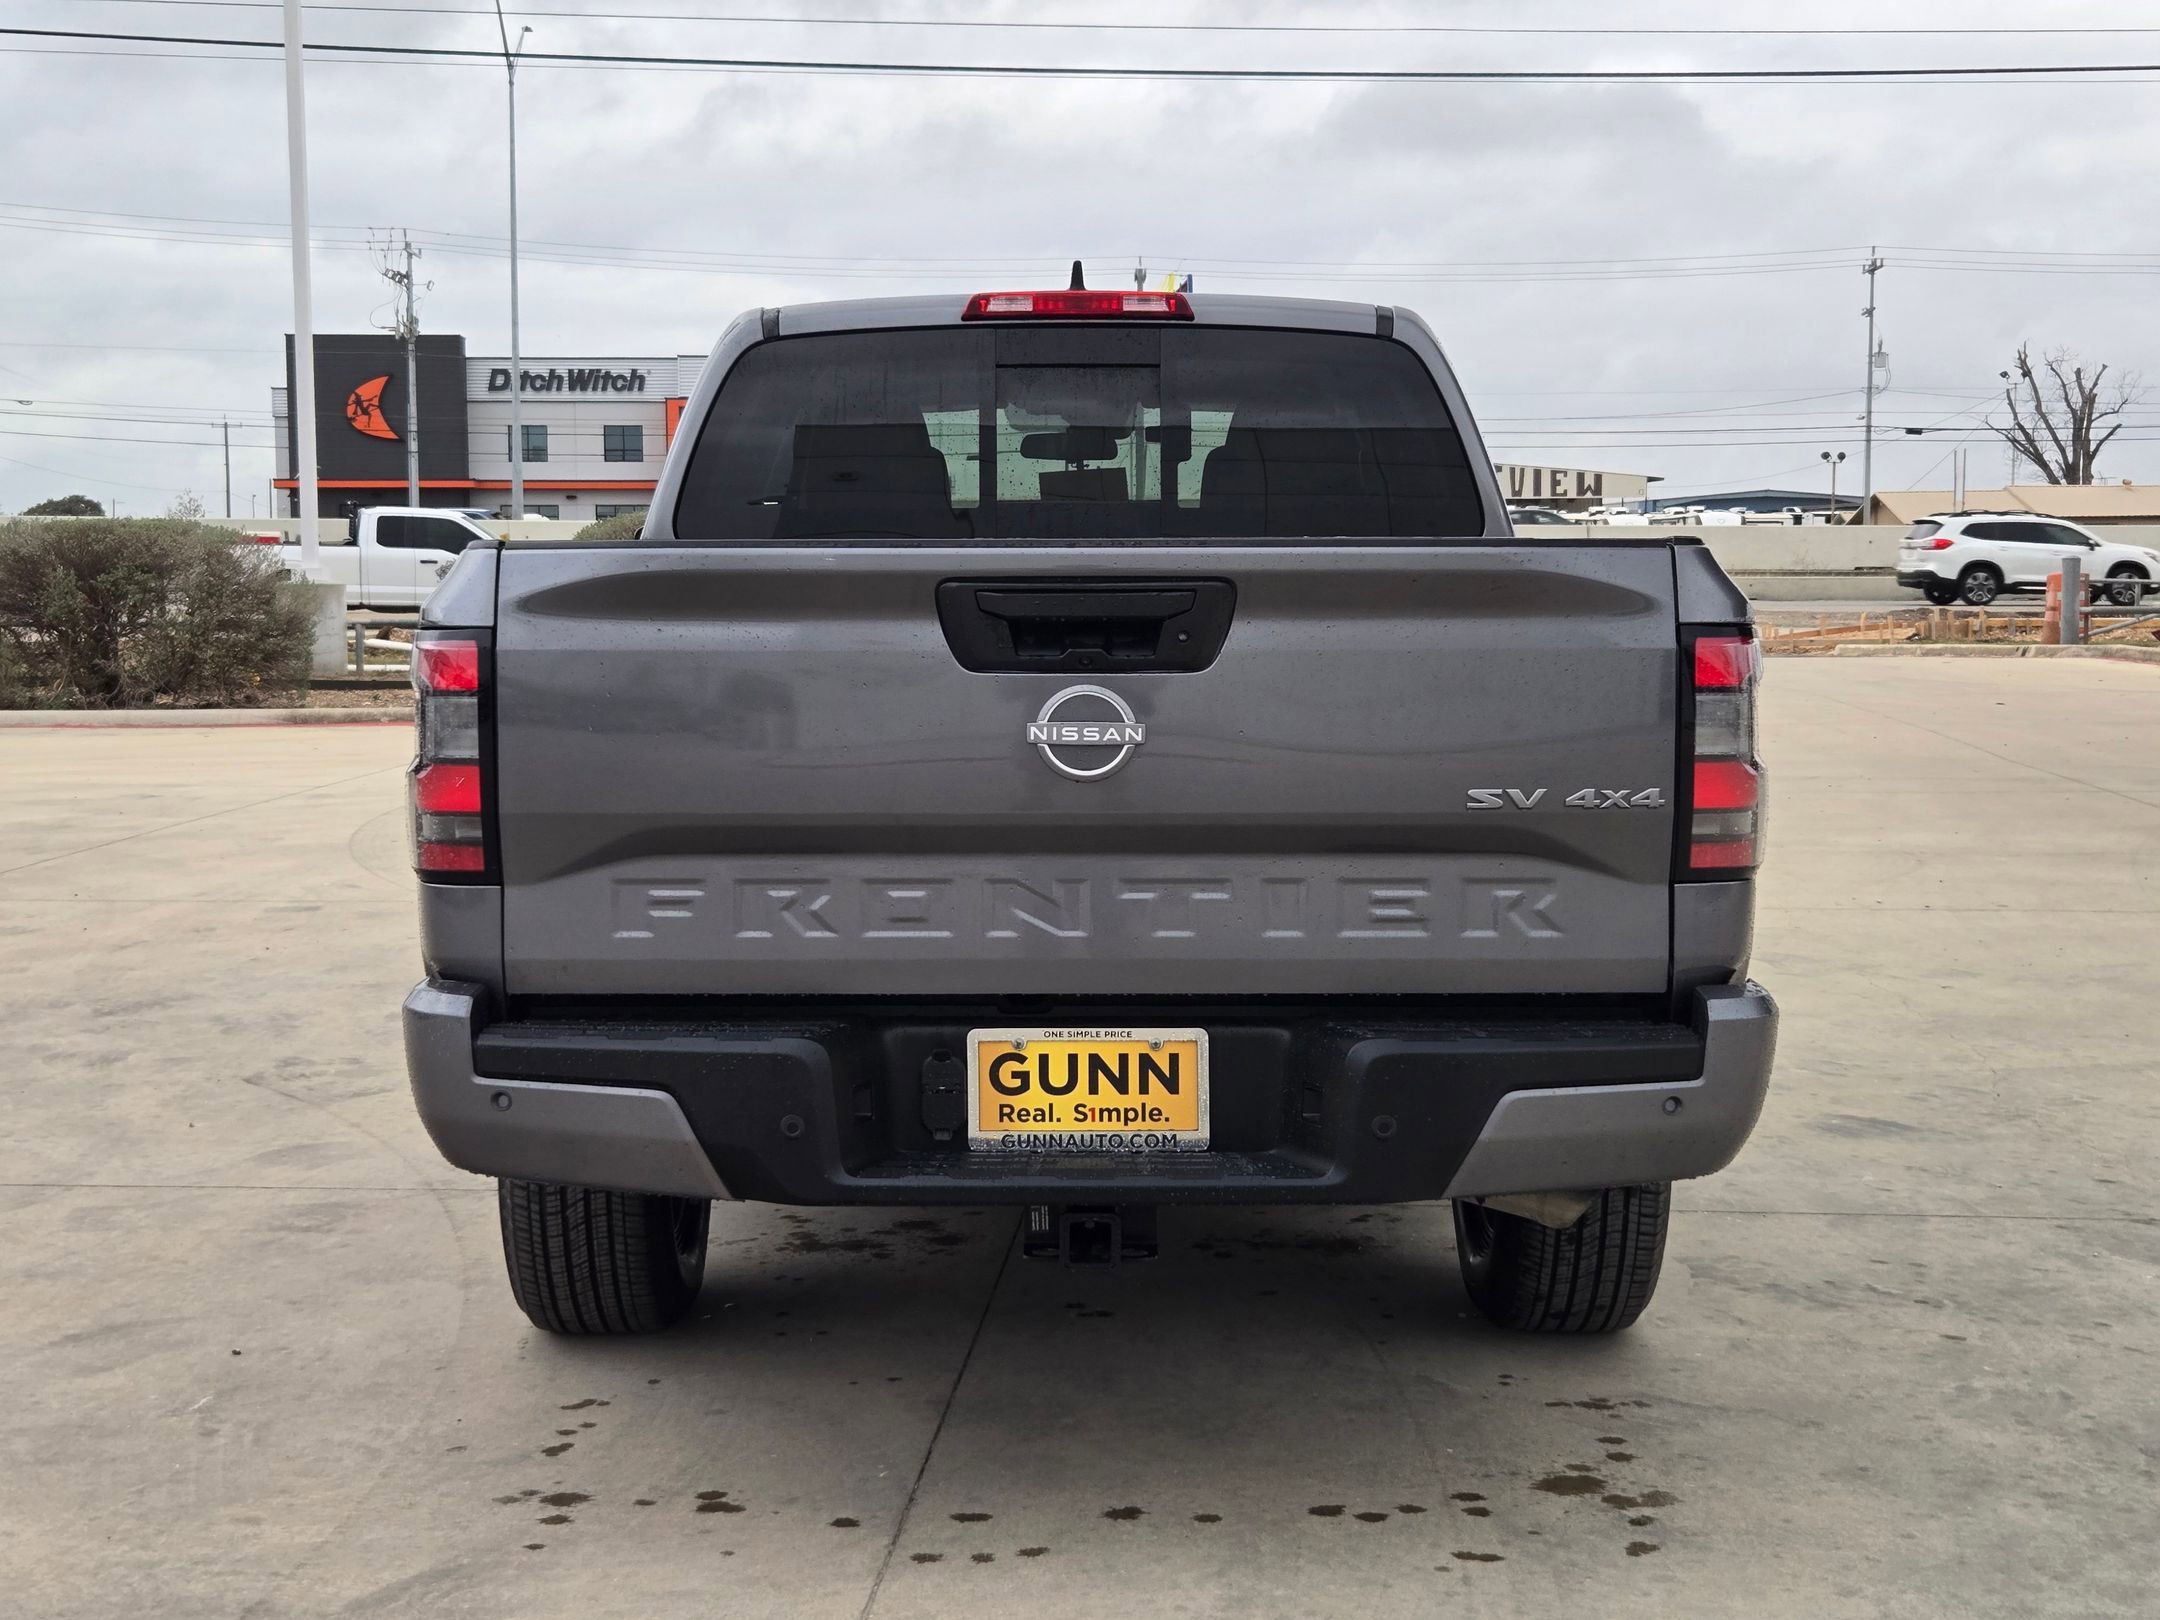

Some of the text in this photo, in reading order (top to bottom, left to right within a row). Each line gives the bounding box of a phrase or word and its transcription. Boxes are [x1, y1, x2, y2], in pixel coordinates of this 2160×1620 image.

[488, 369, 646, 392] Dtch Witch
[1495, 465, 1603, 497] VIEW
[1030, 726, 1142, 741] NISSAN
[1466, 787, 1666, 808] SV 4x4
[611, 877, 1565, 941] FRONTIER
[1043, 1030, 1133, 1038] ONE SIMPLE PRICE
[988, 1052, 1180, 1096] GUNN
[998, 1102, 1062, 1123] Real.
